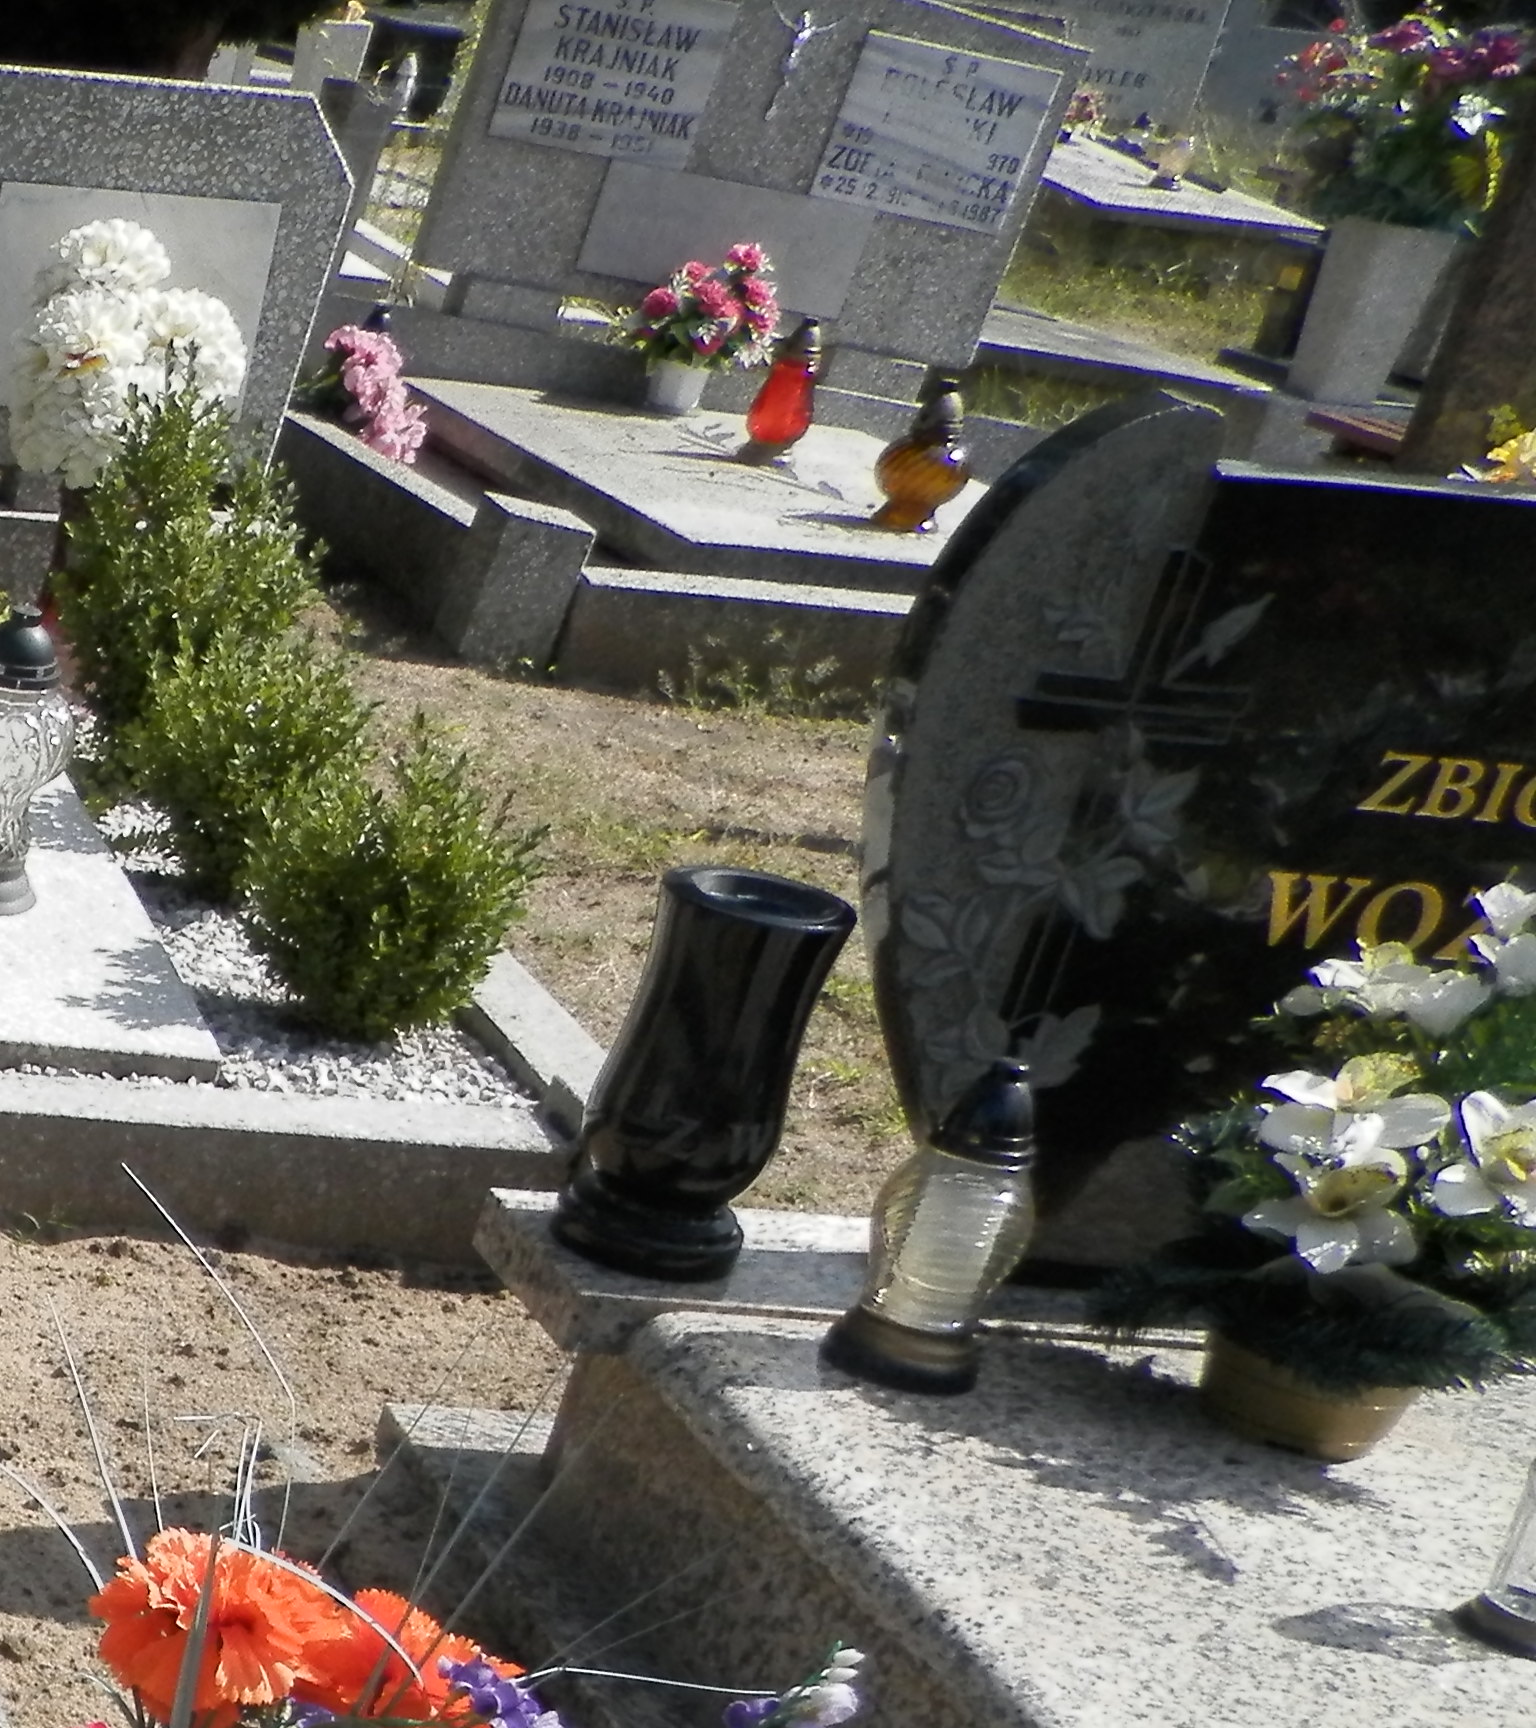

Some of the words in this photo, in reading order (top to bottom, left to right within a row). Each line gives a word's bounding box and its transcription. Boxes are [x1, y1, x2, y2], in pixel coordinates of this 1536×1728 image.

[555, 4, 701, 52] STANISŁAW
[554, 35, 679, 82] KRAJNIAK
[545, 66, 596, 90] 1908
[624, 81, 675, 106] 1940
[505, 81, 587, 119] DANUTA
[591, 98, 696, 140] KRAJNIAK
[530, 117, 582, 142] 1938
